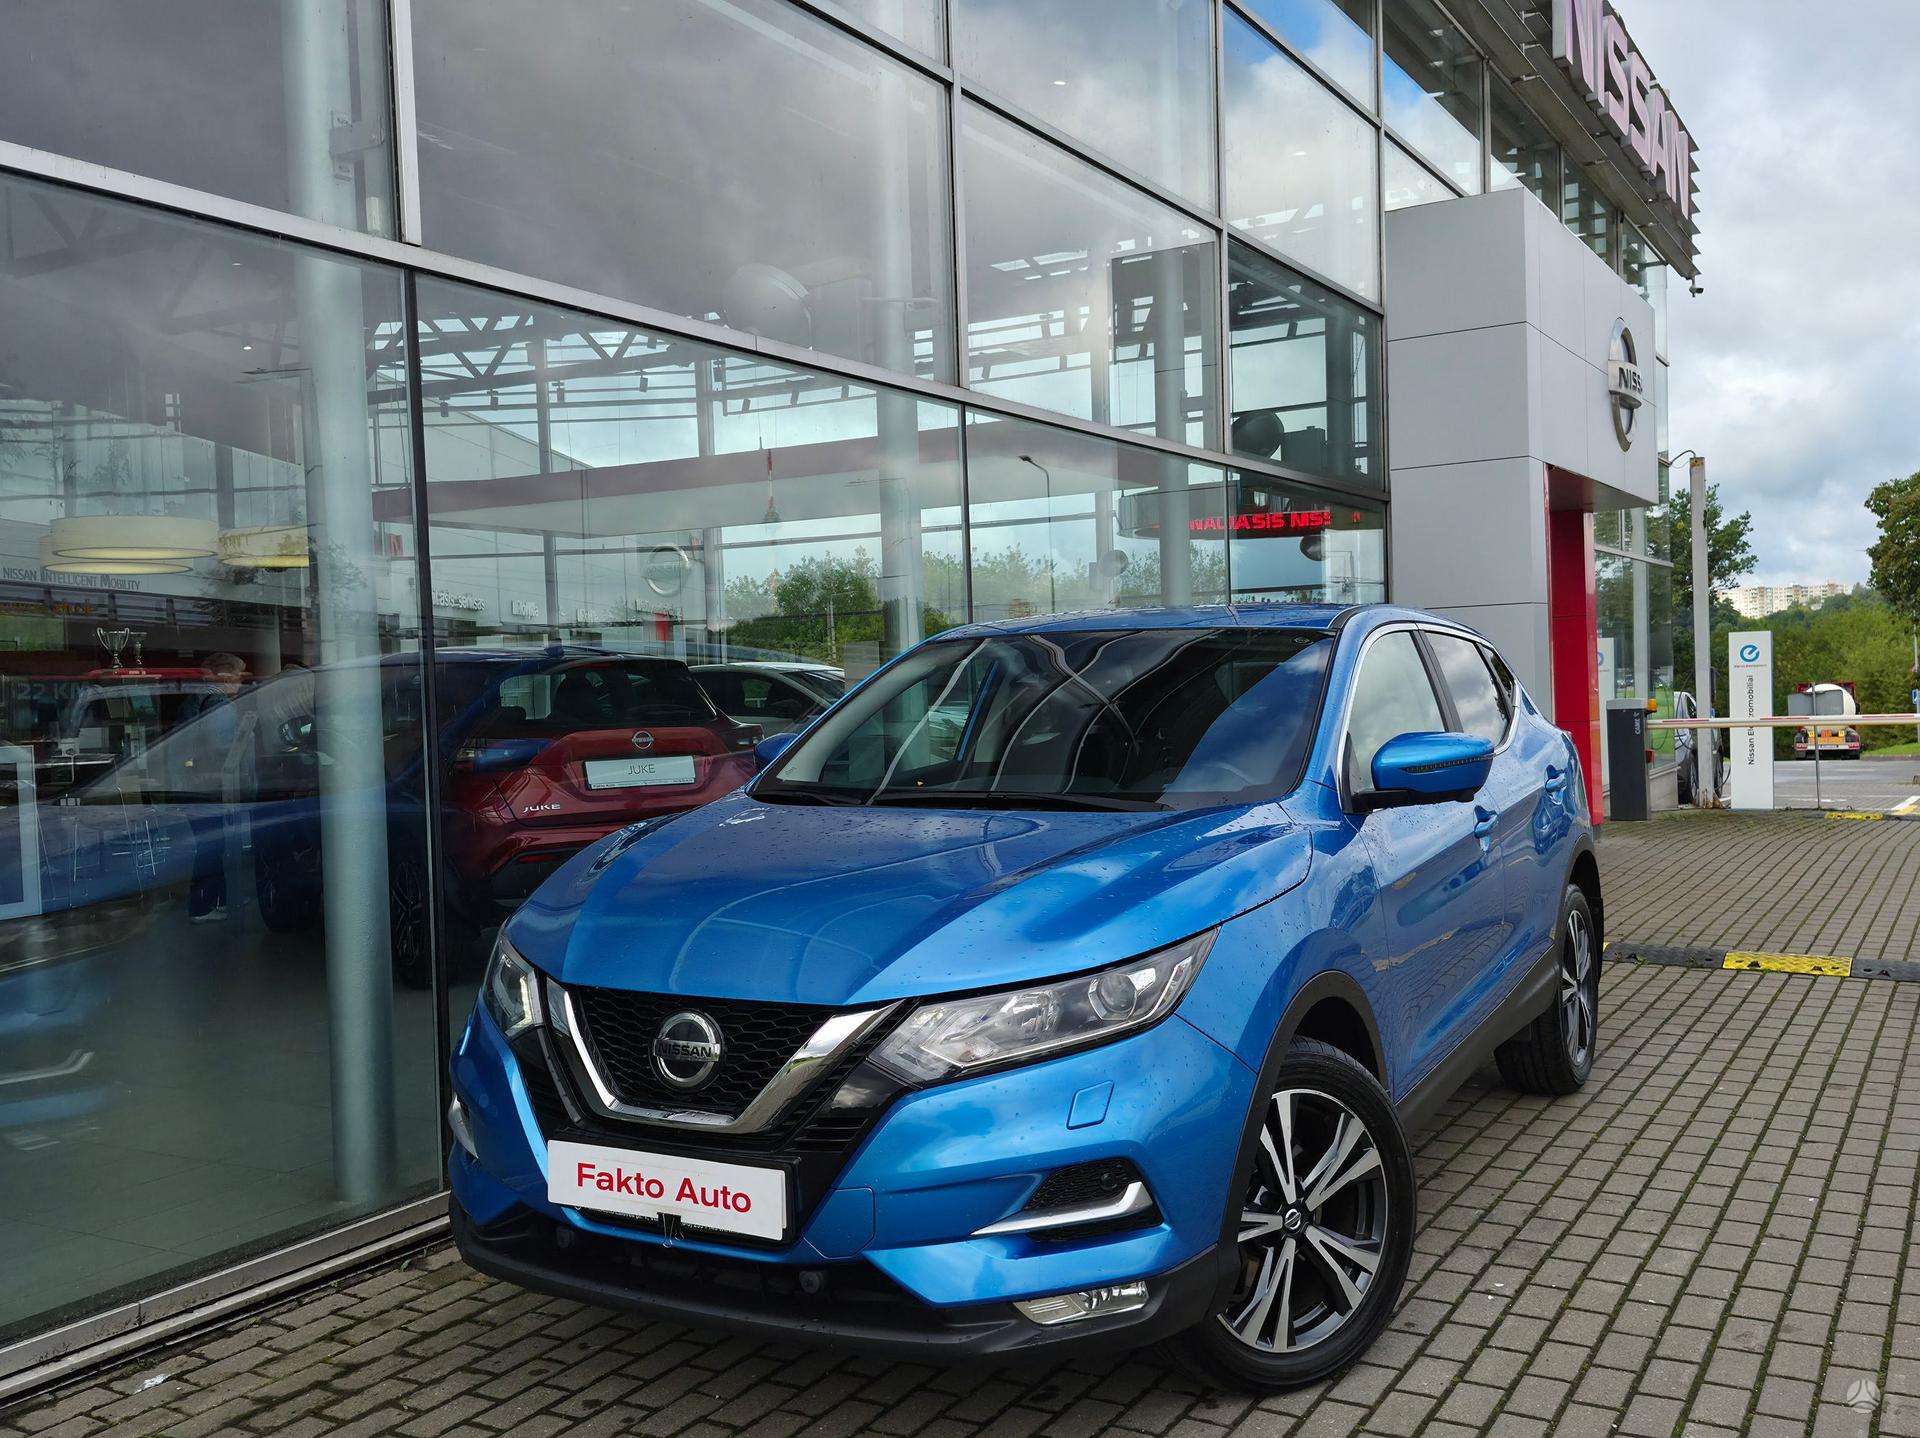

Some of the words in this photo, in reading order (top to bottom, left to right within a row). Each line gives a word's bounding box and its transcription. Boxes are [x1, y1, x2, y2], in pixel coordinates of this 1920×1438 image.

[1552, 0, 1689, 220] NISSAN
[2, 567, 37, 581] NISSAN
[100, 574, 140, 590] MOBILITY
[628, 764, 656, 775] JUKE
[523, 803, 561, 813] JUKE
[659, 1042, 712, 1058] NISSAN
[577, 1163, 665, 1199] Fakto
[675, 1177, 752, 1213] Auto
